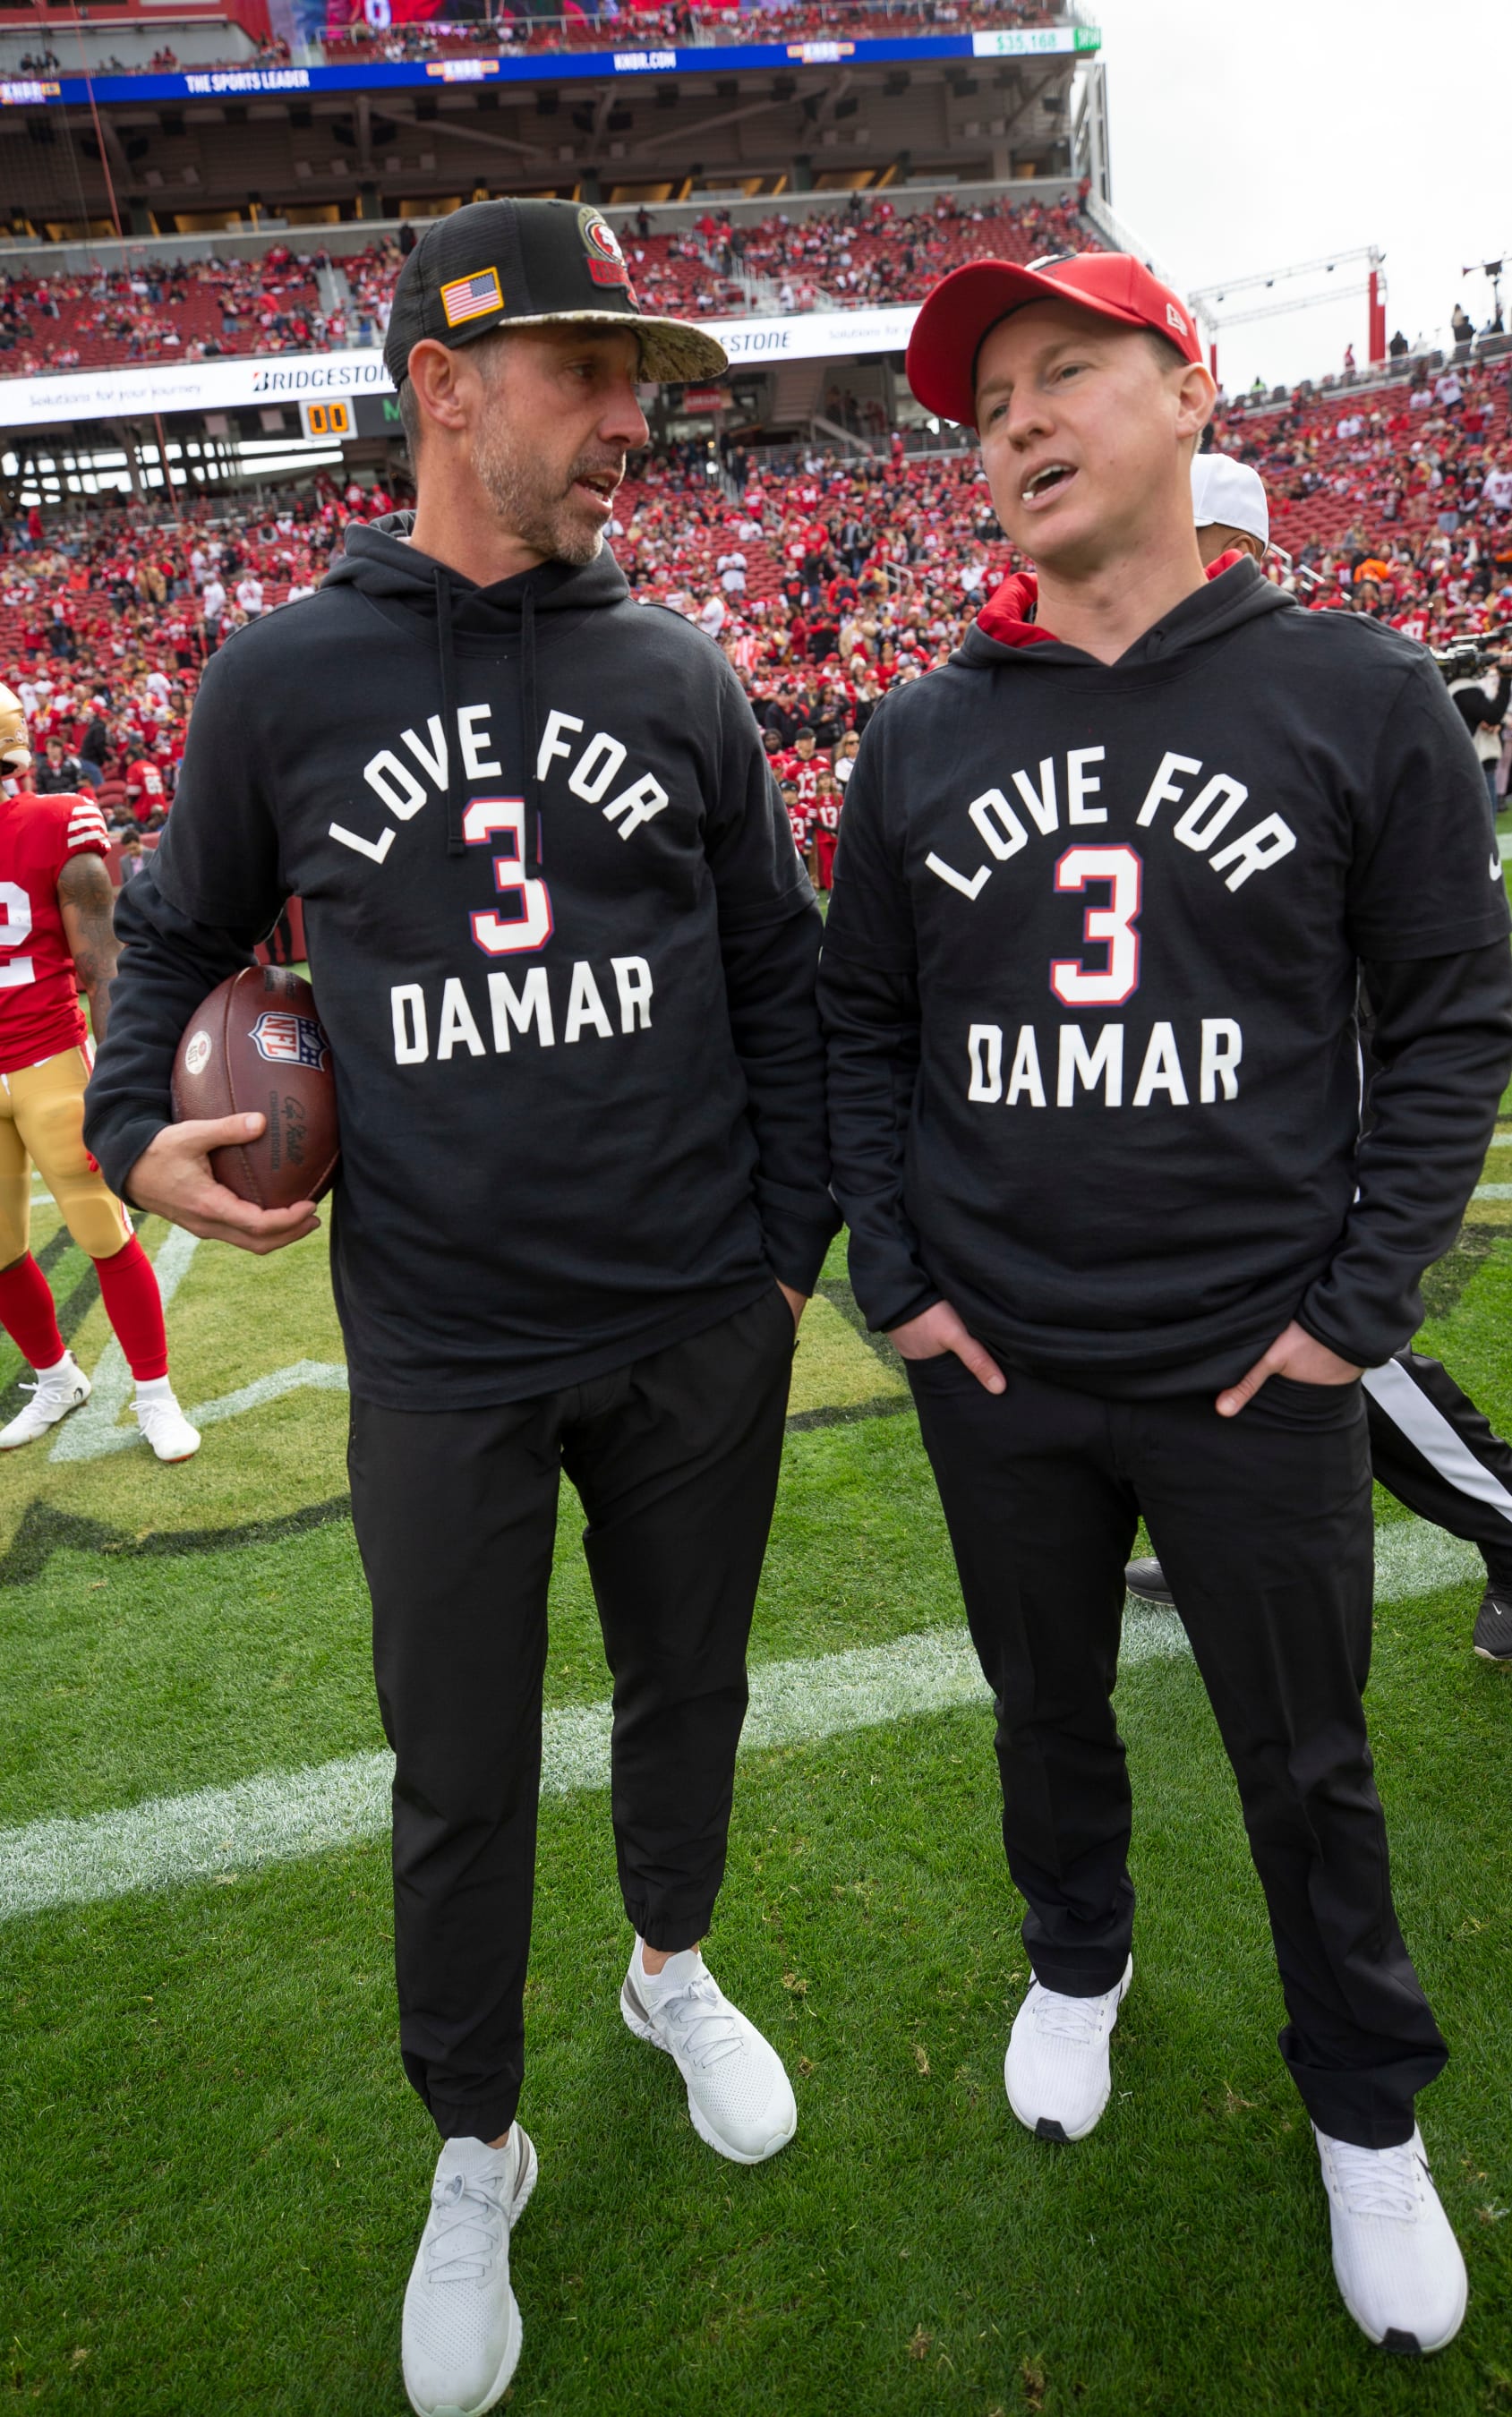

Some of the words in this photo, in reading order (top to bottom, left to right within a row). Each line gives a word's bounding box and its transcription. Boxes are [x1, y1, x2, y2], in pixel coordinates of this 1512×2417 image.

[184, 75, 211, 93] THE
[211, 72, 261, 92] SPORTS
[261, 69, 310, 90] LEADER
[309, 403, 348, 434] 00
[328, 704, 502, 865] LOVE
[534, 709, 670, 841] FOR
[925, 746, 1108, 901] LOVE
[1136, 751, 1297, 892] FOR
[462, 796, 555, 957] 3
[1049, 842, 1143, 1008] 3
[261, 1017, 297, 1055] NFL
[390, 955, 654, 1065] DAMAR
[968, 1018, 1243, 1107] DAMAR
